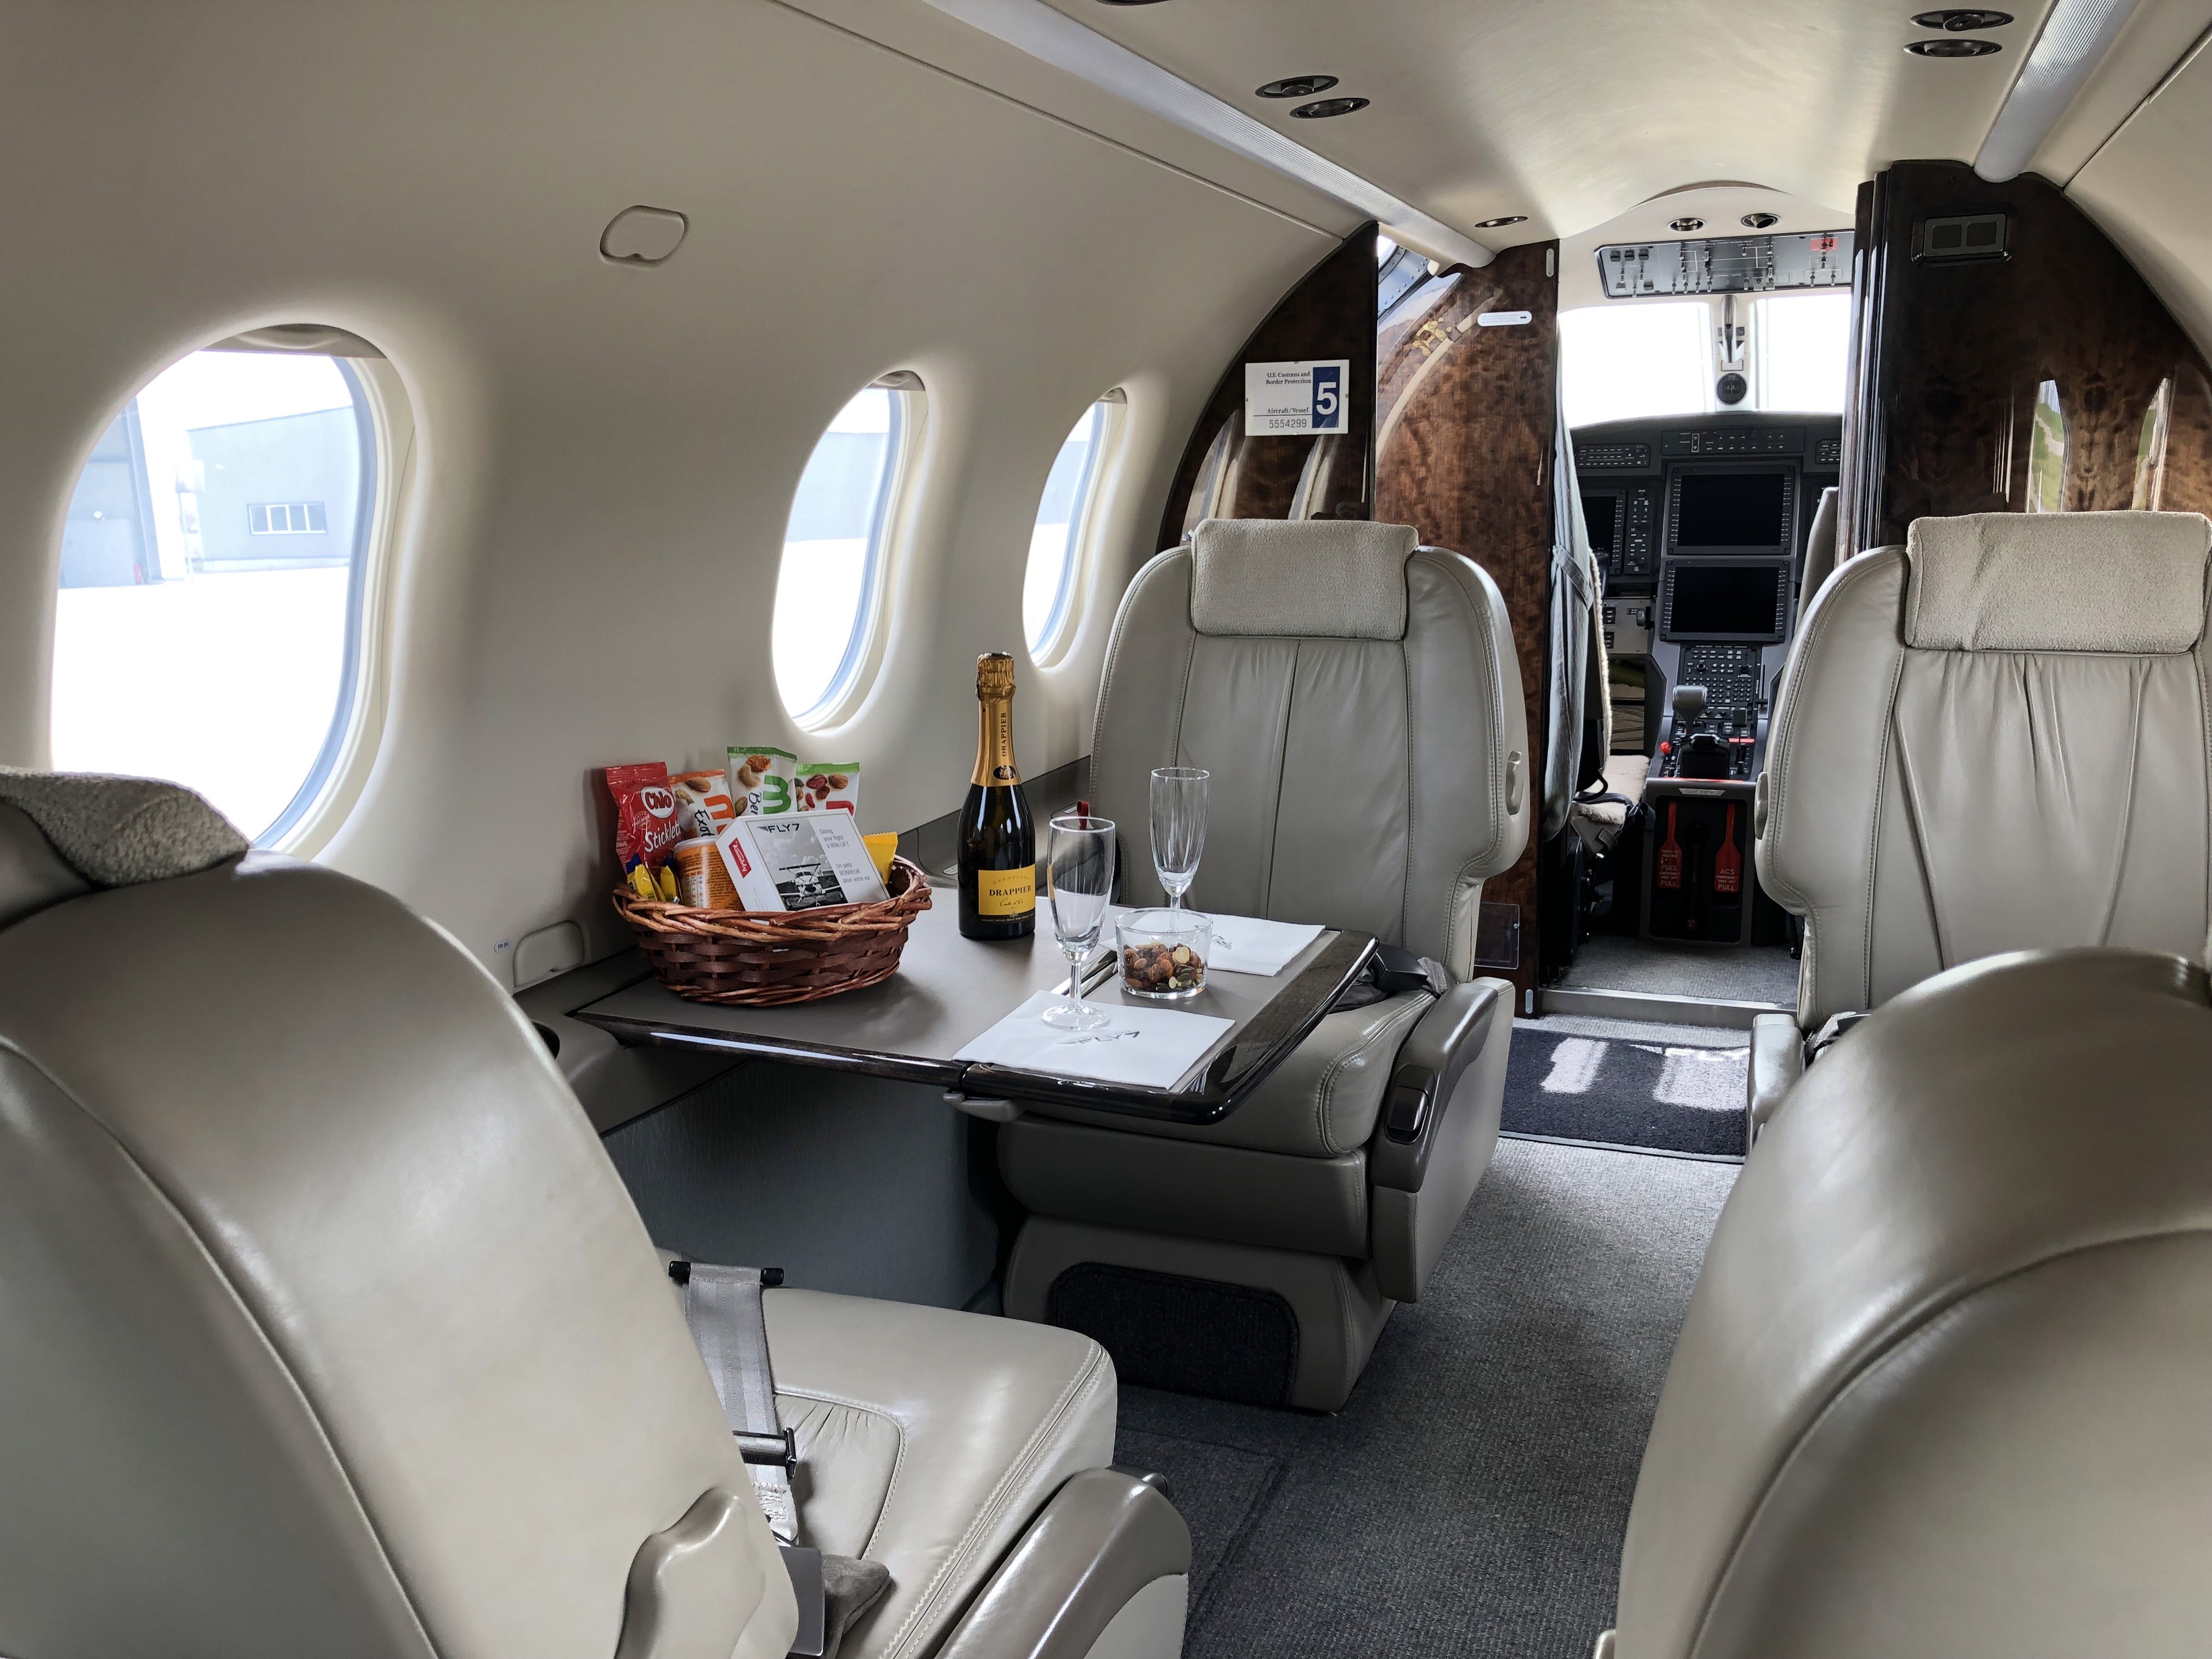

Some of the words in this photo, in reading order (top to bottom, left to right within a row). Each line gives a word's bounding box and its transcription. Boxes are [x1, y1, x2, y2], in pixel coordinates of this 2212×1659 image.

[1316, 381, 1338, 415] 5
[1269, 419, 1307, 428] 5554299
[645, 791, 672, 810] Chio
[768, 823, 800, 833] FLY7
[989, 885, 1031, 896] DRAPPIER
